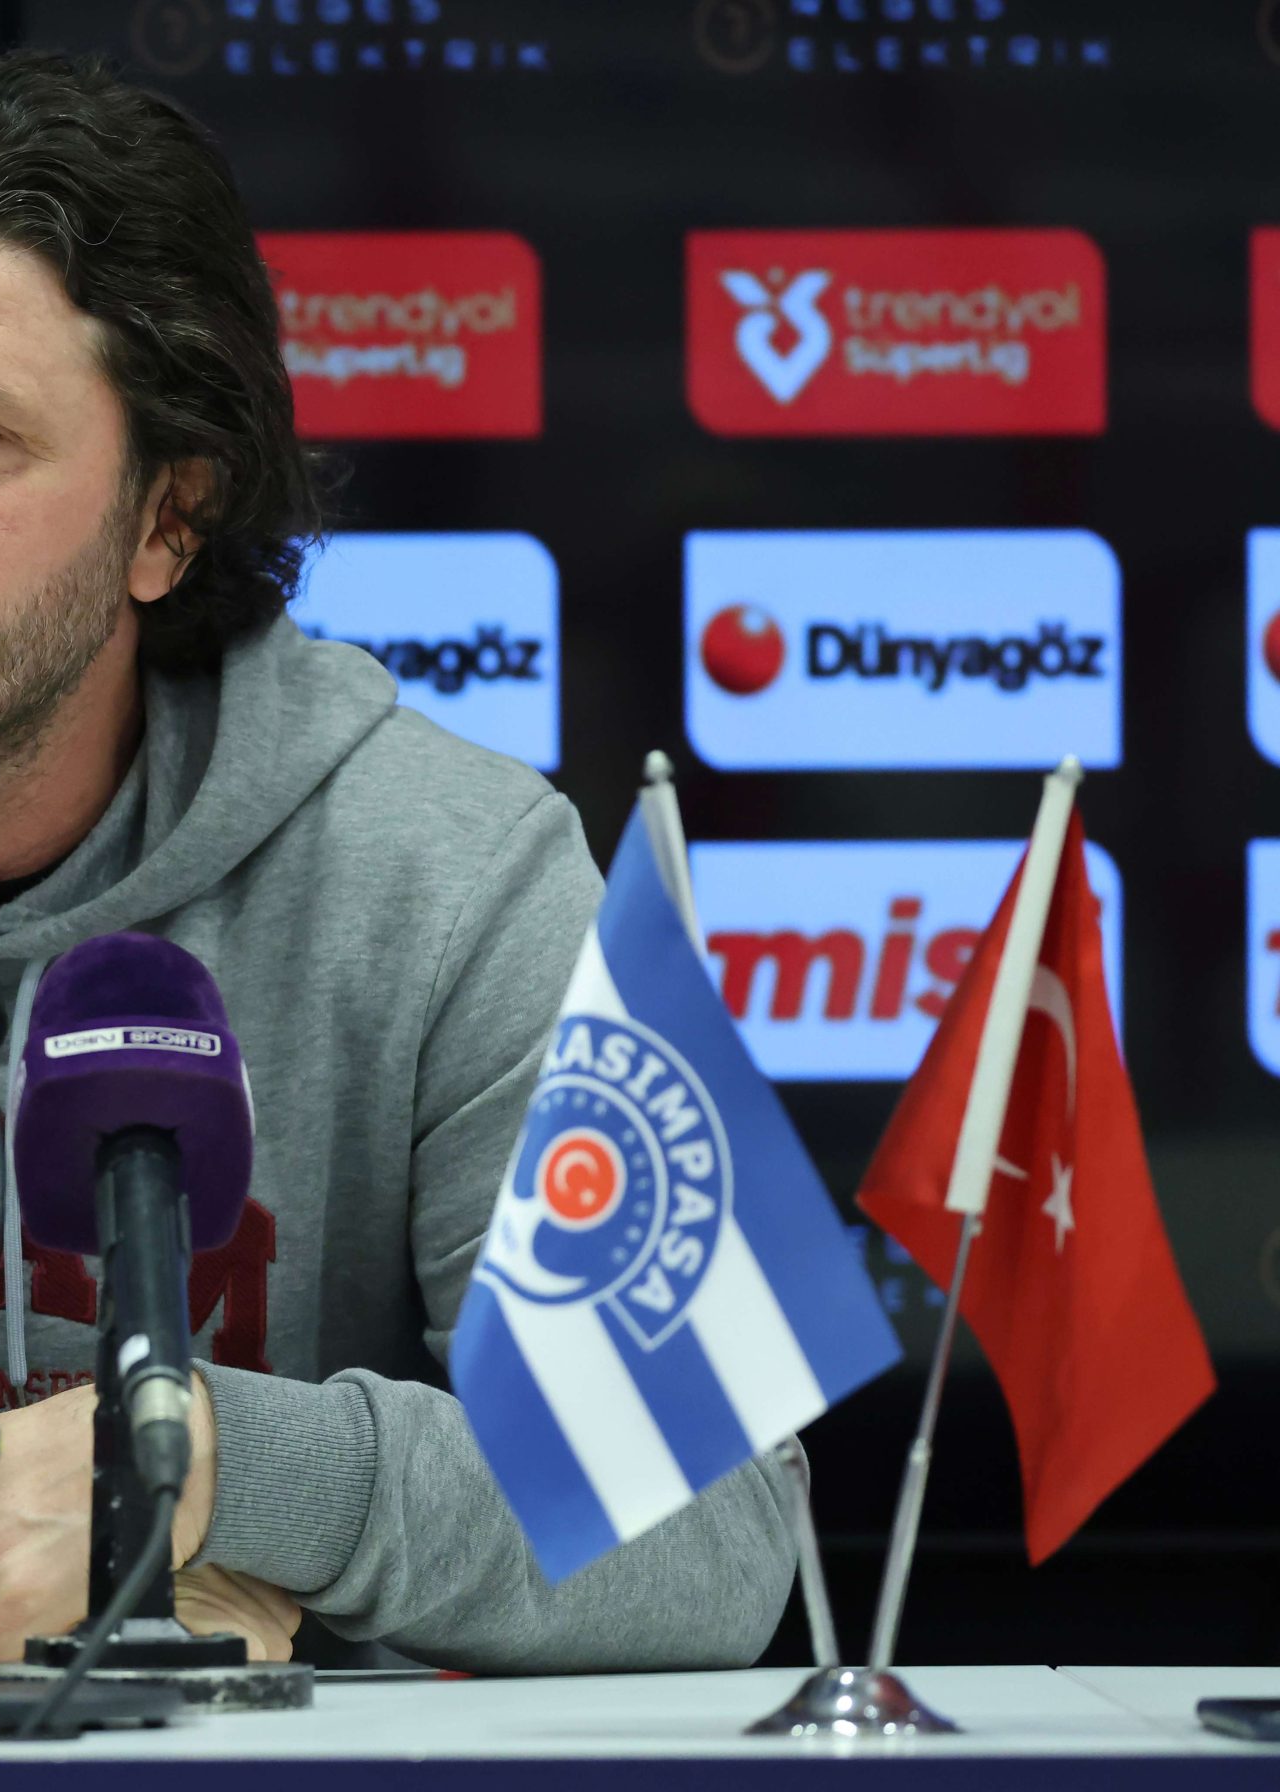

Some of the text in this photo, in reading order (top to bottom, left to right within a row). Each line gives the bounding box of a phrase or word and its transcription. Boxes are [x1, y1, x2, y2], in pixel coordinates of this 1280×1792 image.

[280, 285, 518, 340] trendyol
[845, 281, 1080, 338] trendyol
[808, 621, 1102, 691] Dünyagöz
[707, 898, 992, 1020] mis
[130, 1031, 213, 1050] SPORTS
